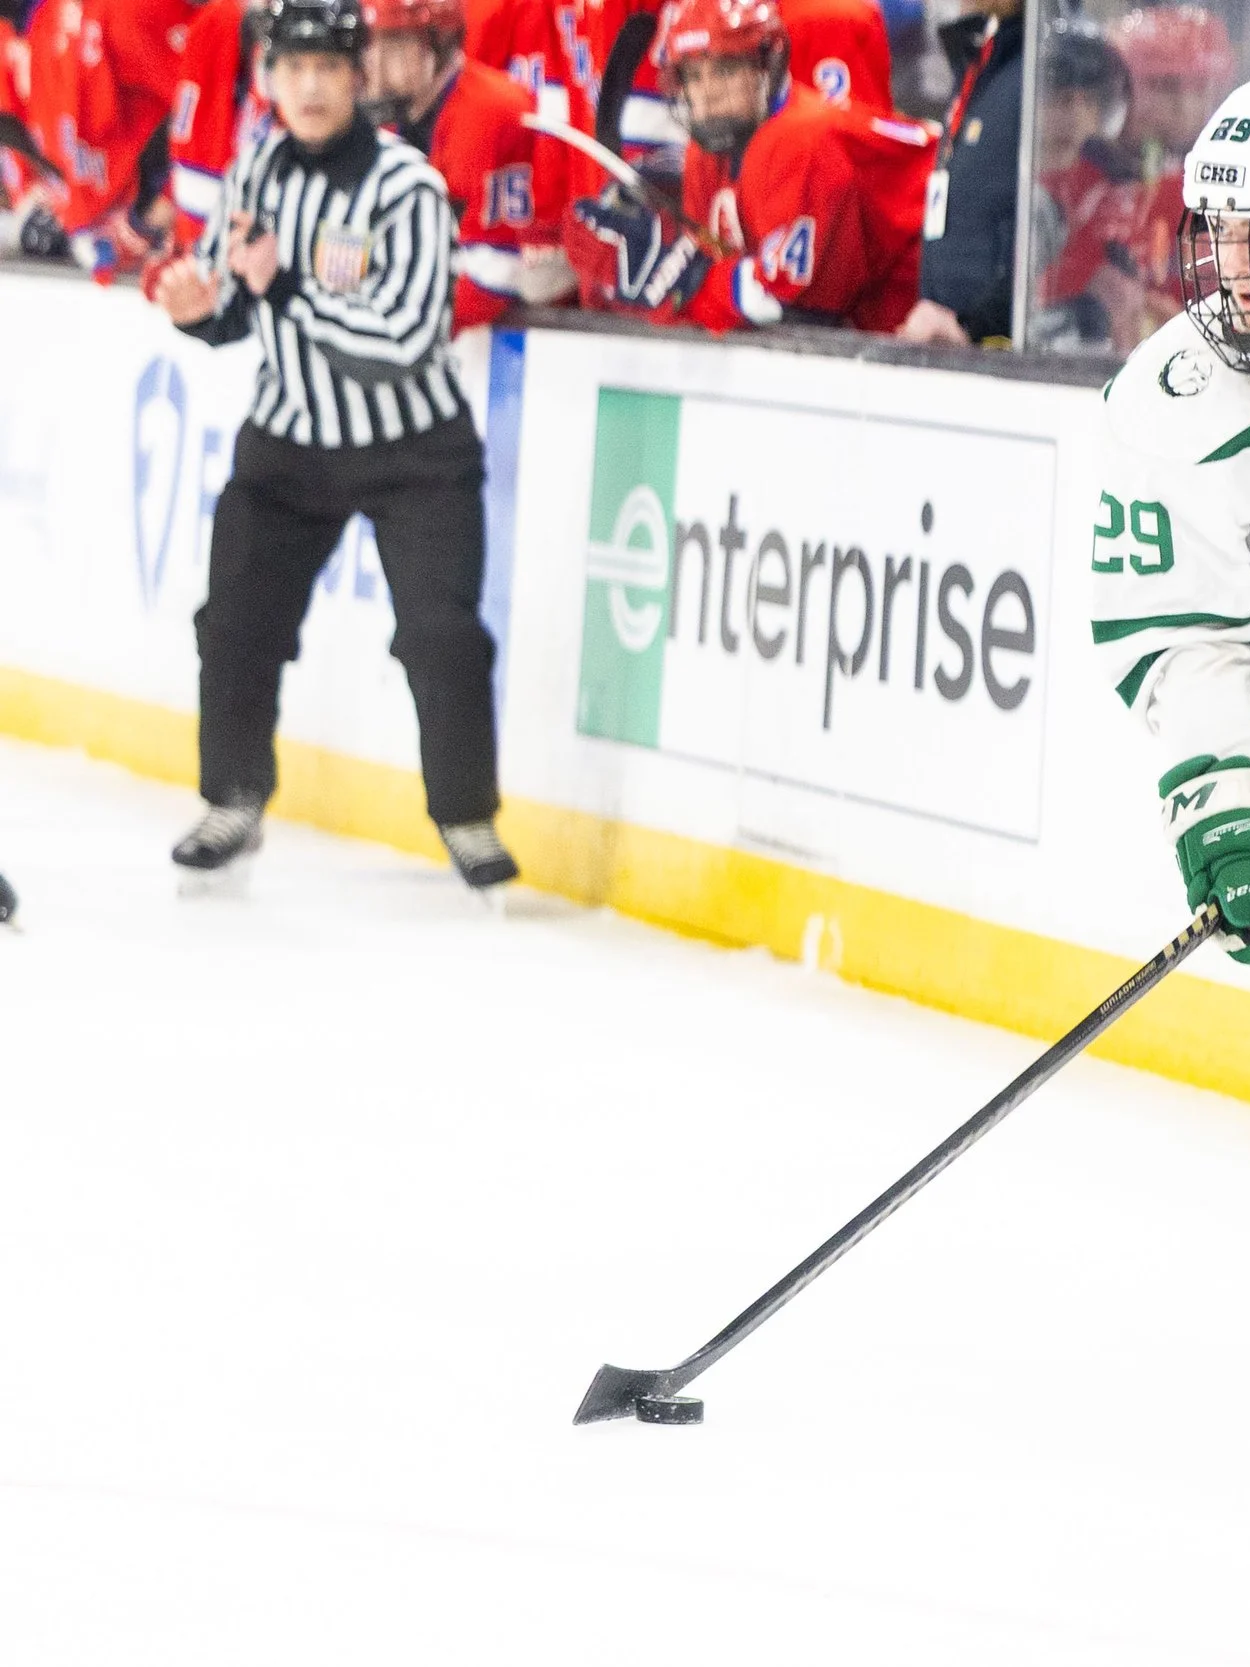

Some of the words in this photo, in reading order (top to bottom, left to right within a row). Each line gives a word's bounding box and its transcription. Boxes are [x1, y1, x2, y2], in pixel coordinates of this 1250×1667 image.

[480, 162, 536, 231] 15
[1091, 489, 1175, 576] 29
[587, 484, 1036, 732] enterprise
